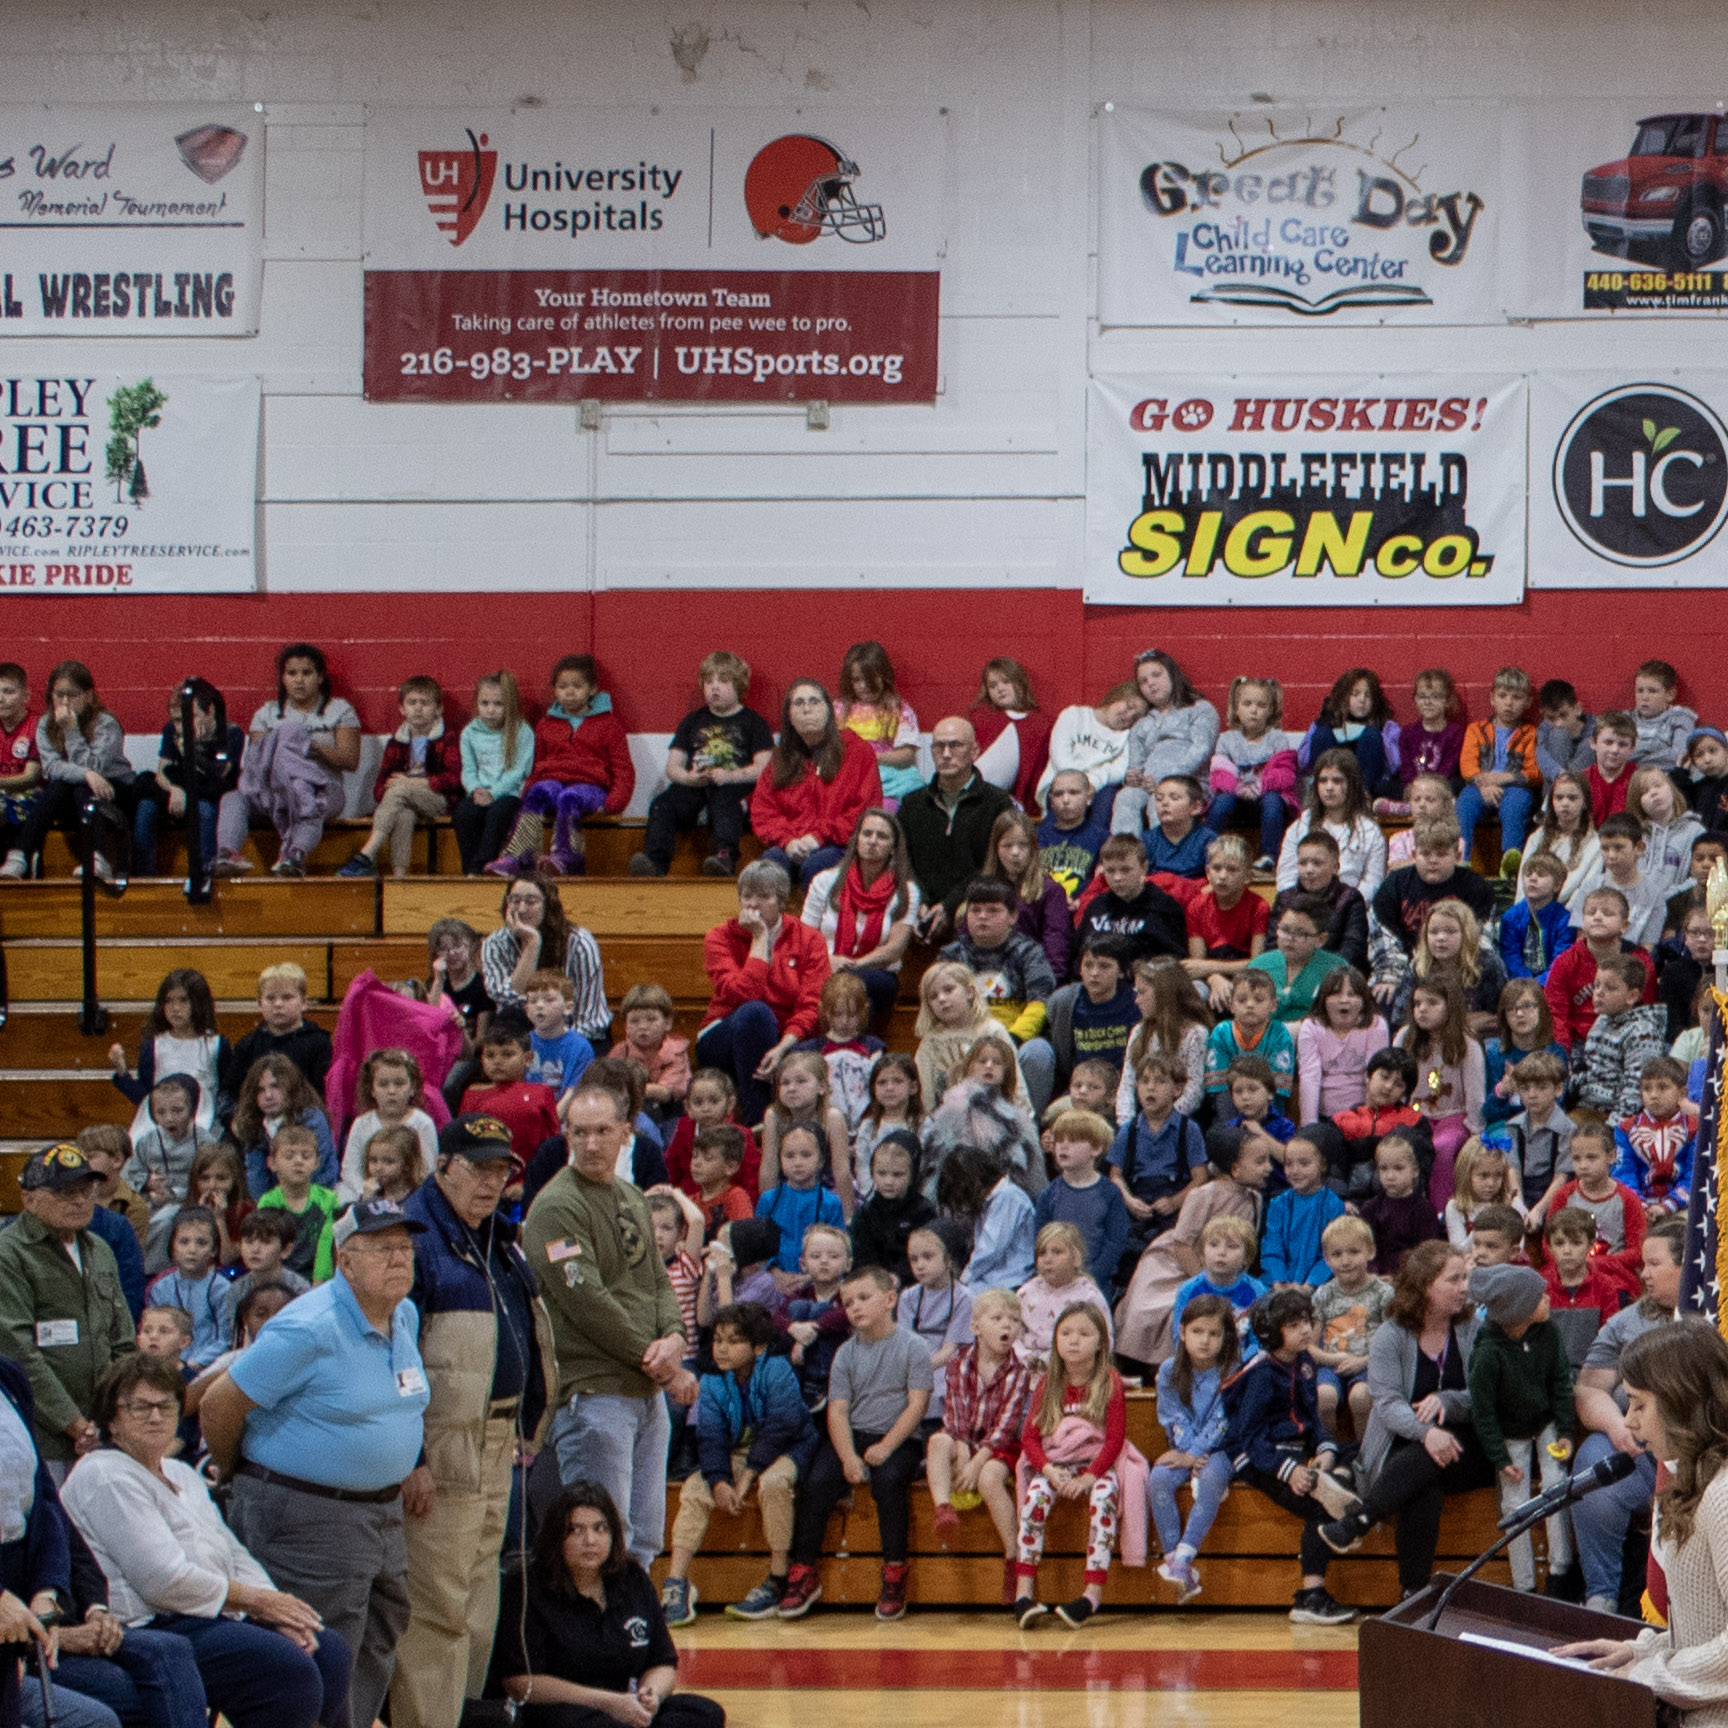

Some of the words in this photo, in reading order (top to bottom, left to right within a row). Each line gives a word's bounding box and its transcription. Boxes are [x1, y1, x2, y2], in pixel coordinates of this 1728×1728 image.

[29, 143, 116, 180] Ward
[424, 160, 459, 186] UH
[505, 161, 682, 198] University
[19, 190, 107, 218] Memorial
[113, 190, 226, 217] Tournament
[504, 200, 663, 238] Hospitals
[1139, 161, 1339, 217] Great
[1350, 168, 1486, 267] Day
[1192, 216, 1271, 250] Child
[1280, 217, 1349, 247] Care
[1173, 231, 1310, 284] Learning
[1313, 249, 1409, 280] Center
[38, 272, 235, 318] WRESTLING
[534, 289, 585, 307] Your
[591, 288, 708, 307] Hometown
[712, 288, 771, 307] Team
[1587, 273, 1712, 291] 440-636-5111
[452, 315, 511, 334] Taking
[517, 318, 555, 331] care
[560, 313, 579, 331] of
[584, 314, 655, 331] athletes
[660, 313, 704, 331] from
[709, 318, 743, 334] pee
[748, 317, 786, 331] wee
[792, 314, 811, 331] to
[815, 318, 852, 334] pro.
[400, 347, 642, 379] 216-983-PLAY
[675, 347, 903, 384] UHSports.org
[1129, 397, 1214, 432] GO
[1227, 397, 1488, 432] HUSKIES!
[1142, 452, 1468, 508] MIDDLEFIELD
[1589, 450, 1705, 518] HC
[66, 545, 250, 557] RIPLEYTREESERVICE.com
[1118, 509, 1373, 578] SIGN
[44, 564, 133, 586] PRIDE
